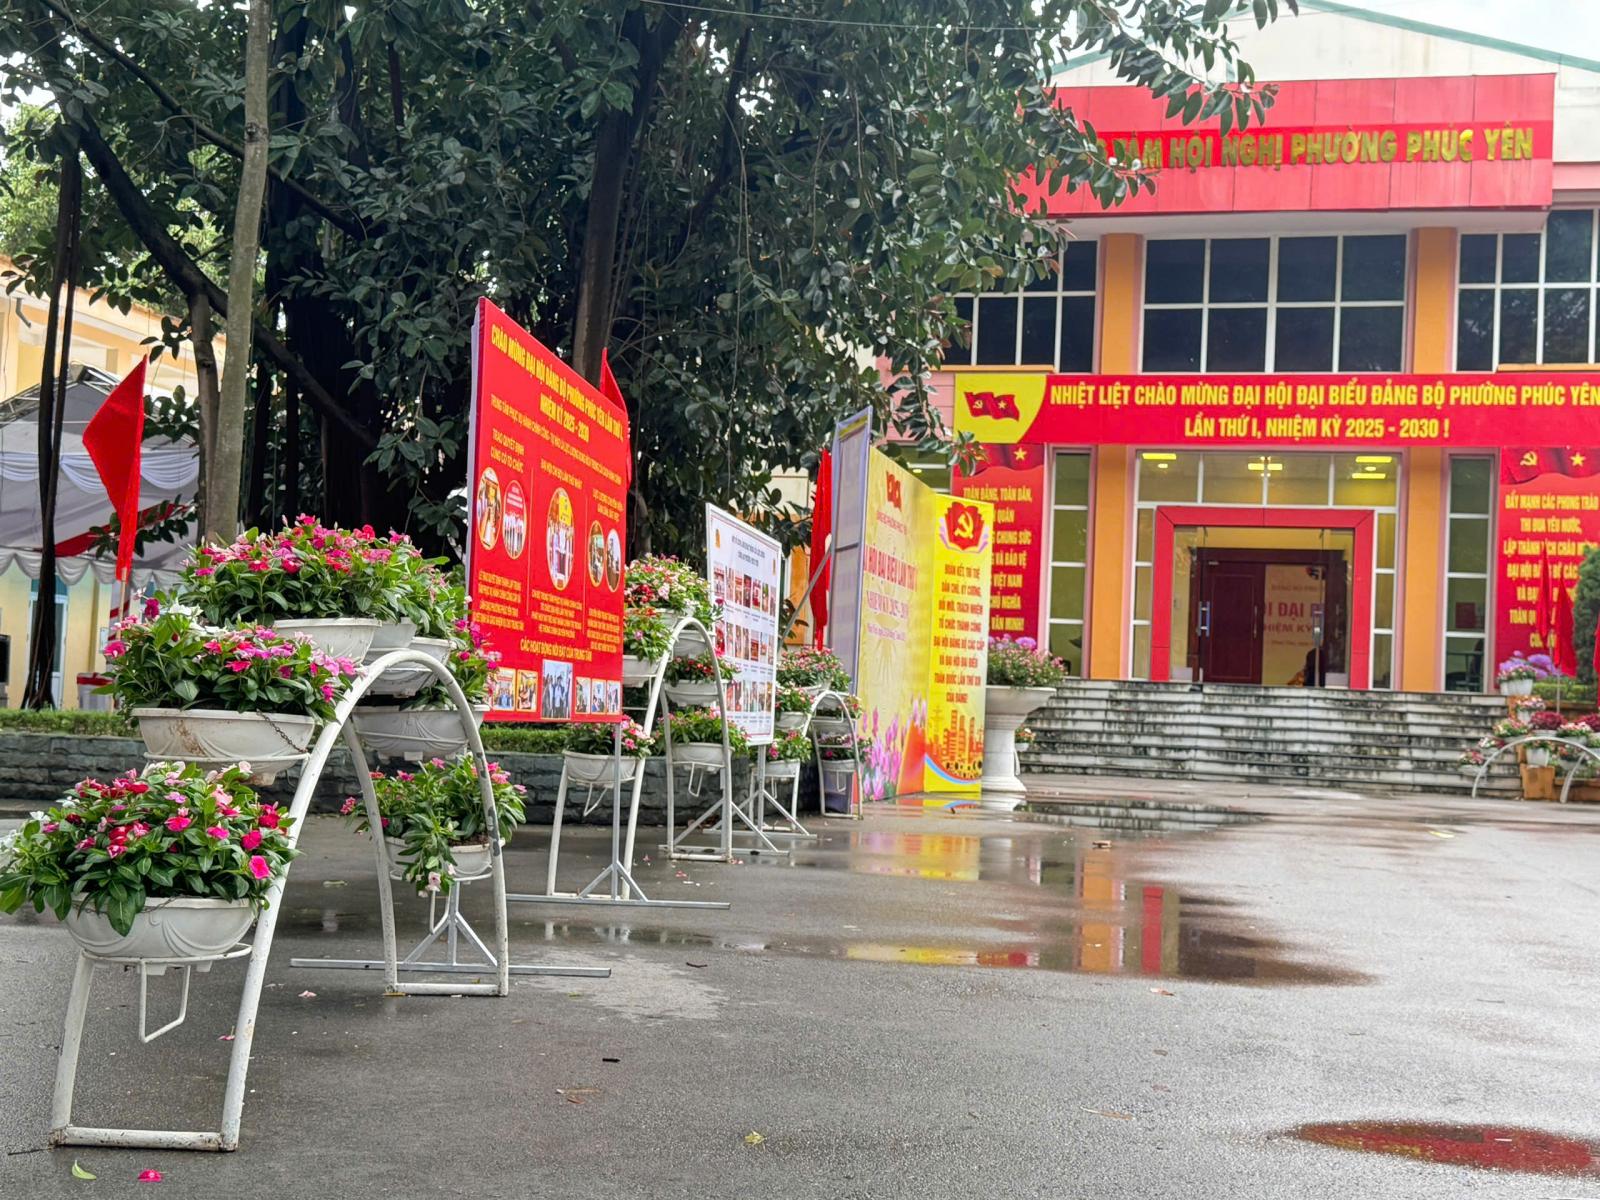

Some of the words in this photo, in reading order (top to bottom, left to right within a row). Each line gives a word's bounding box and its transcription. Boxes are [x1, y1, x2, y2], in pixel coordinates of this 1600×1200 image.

[1114, 131, 1162, 168] ÂM
[1169, 129, 1213, 173] HỘI
[1221, 134, 1283, 171] NGHỊ
[1290, 124, 1397, 165] PHƯỜNG
[1406, 124, 1474, 163] PHÚC
[1483, 120, 1533, 161] YÊN
[1050, 381, 1095, 409] NHIỆT
[1099, 381, 1131, 409] LIỆT
[1134, 381, 1177, 405] CHÀO
[1181, 381, 1228, 405] MỪNG
[1232, 385, 1260, 409] ĐẠI
[1264, 381, 1293, 409] HỘI
[1296, 385, 1324, 409] ĐẠI
[1329, 377, 1367, 405] BIỂU
[1371, 378, 1418, 405] ĐẢNG
[1422, 381, 1446, 409] BỘ
[1450, 380, 1517, 406] PHƯỜNG
[1520, 381, 1566, 405] PHÚC
[1570, 381, 1600, 406] YÊN
[1184, 412, 1215, 437] LẦN
[1218, 414, 1250, 437] THỨ
[1251, 418, 1262, 439] I,
[1265, 414, 1317, 441] NHIỆM
[1321, 414, 1342, 437] KỲ
[1345, 418, 1385, 438] 2025
[1399, 418, 1439, 438] 2030
[1443, 418, 1450, 438] !
